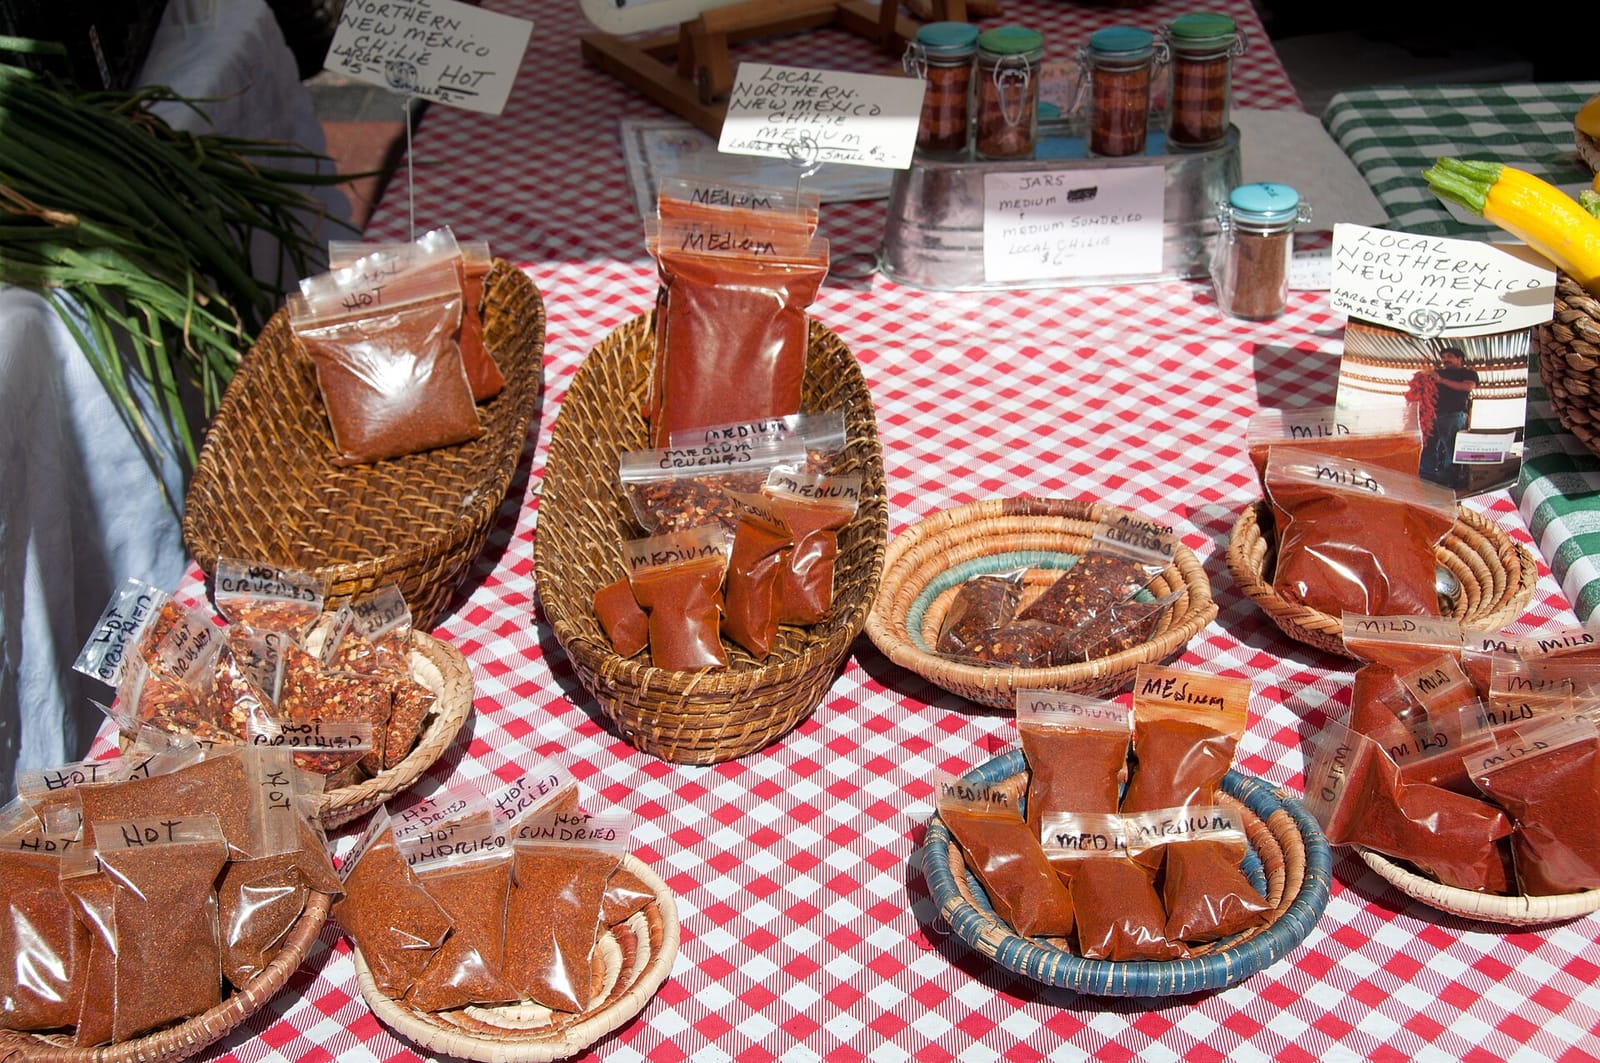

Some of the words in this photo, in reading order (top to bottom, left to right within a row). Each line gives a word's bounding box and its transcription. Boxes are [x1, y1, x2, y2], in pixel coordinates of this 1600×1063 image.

[346, 0, 461, 30] NORTHERN
[338, 14, 396, 36] NEW
[403, 28, 490, 57] MEXICO
[438, 65, 496, 87] HOT
[760, 67, 824, 84] LOCAL
[730, 98, 787, 111] NEW
[1019, 175, 1066, 190] JARS
[999, 196, 1057, 211] MEDIUM
[1357, 231, 1447, 253] LOCAL
[1336, 244, 1489, 274] NORTHERN
[1336, 260, 1403, 283] NEW
[1420, 270, 1541, 293] MEXICO
[342, 285, 387, 312] HOT
[1333, 298, 1380, 318] SMALL
[1334, 288, 1379, 306] LARGE
[1439, 308, 1507, 323] MILD
[1290, 418, 1350, 440] MILD
[778, 477, 859, 500] MEDIUM
[1316, 464, 1378, 492] MILD
[630, 544, 722, 569] MEDIUM
[93, 608, 124, 645] HOT
[1355, 619, 1417, 635] MILD
[1538, 631, 1594, 653] MILD
[1030, 700, 1123, 722] MEDIUM
[1476, 703, 1534, 727] MILD
[1389, 730, 1448, 761] MILD
[44, 761, 110, 790] HOT
[261, 771, 291, 811] HOT
[495, 777, 526, 811] HOT
[403, 799, 438, 822] HOT
[20, 838, 81, 851] HOT
[121, 820, 182, 848] HOT
[419, 825, 460, 844] HOT
